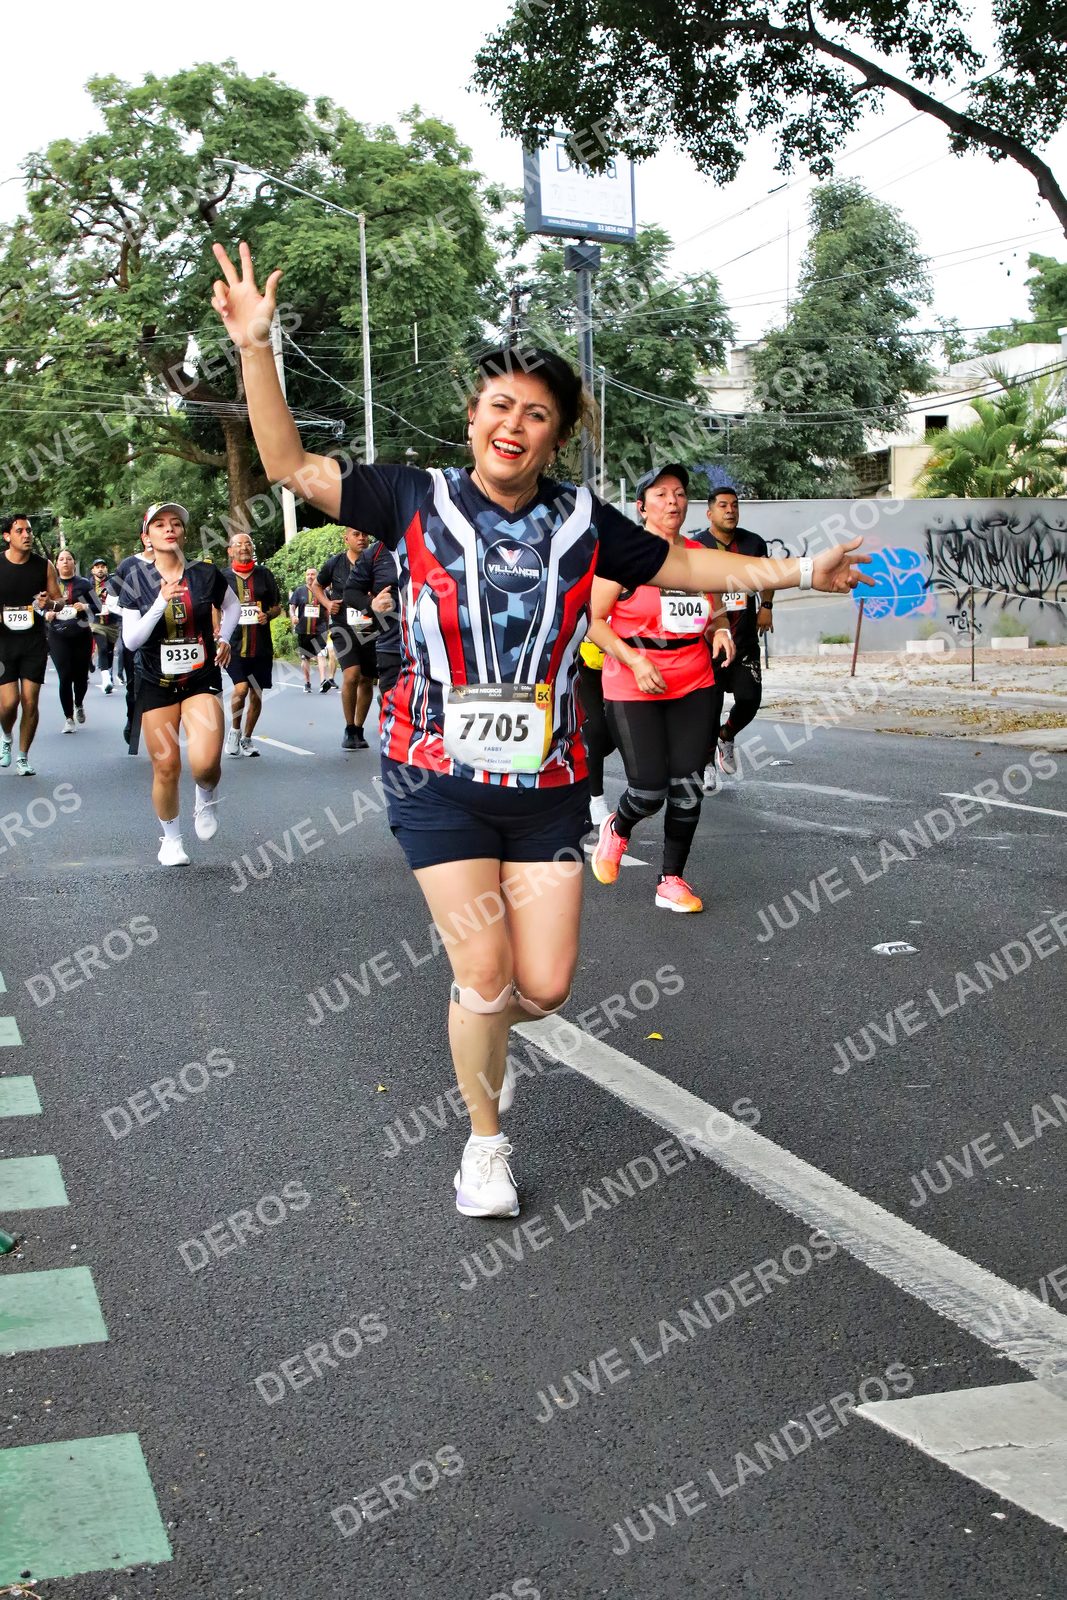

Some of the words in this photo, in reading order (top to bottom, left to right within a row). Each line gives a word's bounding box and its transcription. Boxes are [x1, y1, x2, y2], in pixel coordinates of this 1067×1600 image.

[668, 602, 703, 617] 2004
[8, 613, 28, 622] 5798
[166, 648, 198, 662] 9336
[537, 691, 550, 702] 5K
[459, 712, 530, 742] 7705
